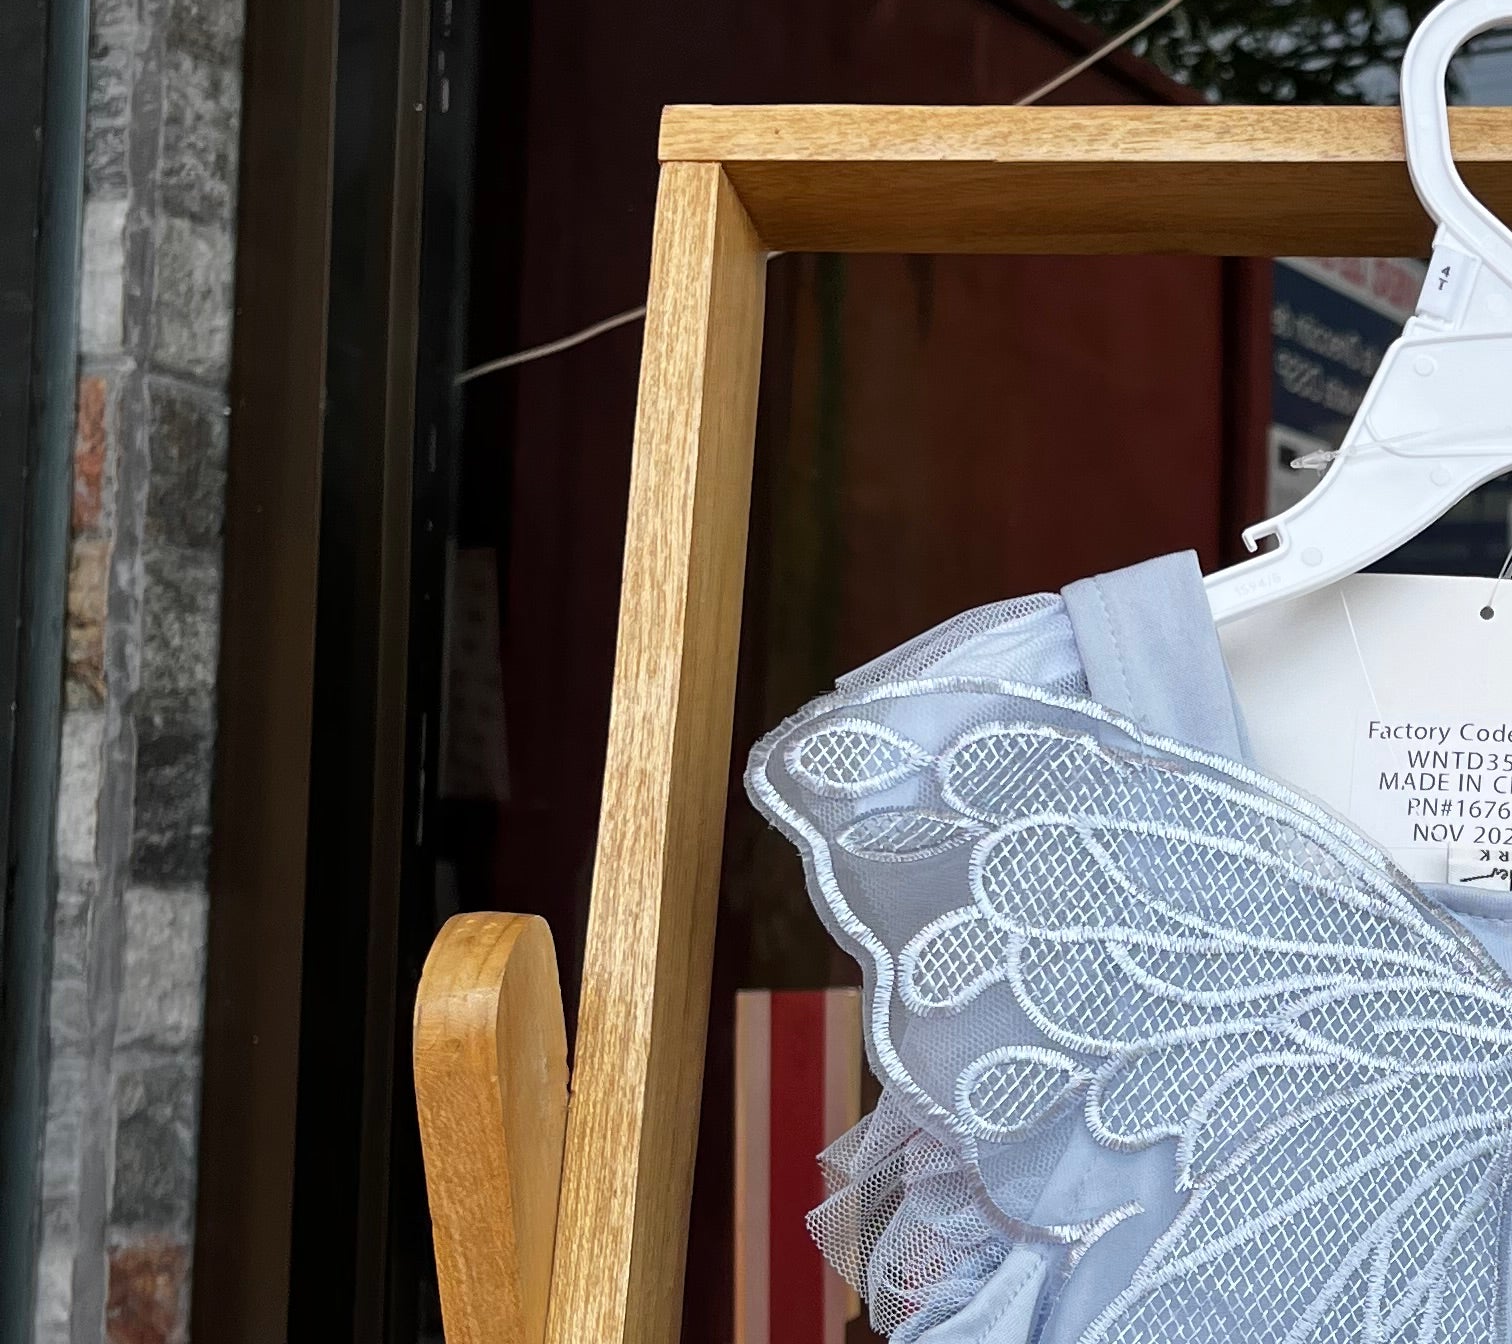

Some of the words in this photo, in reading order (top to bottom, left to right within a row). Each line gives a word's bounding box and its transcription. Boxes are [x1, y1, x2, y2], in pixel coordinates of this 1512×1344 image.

[1368, 721, 1451, 746] Factory
[1379, 772, 1449, 791] MADE
[1458, 773, 1482, 793] IN
[1413, 823, 1465, 842] NOV
